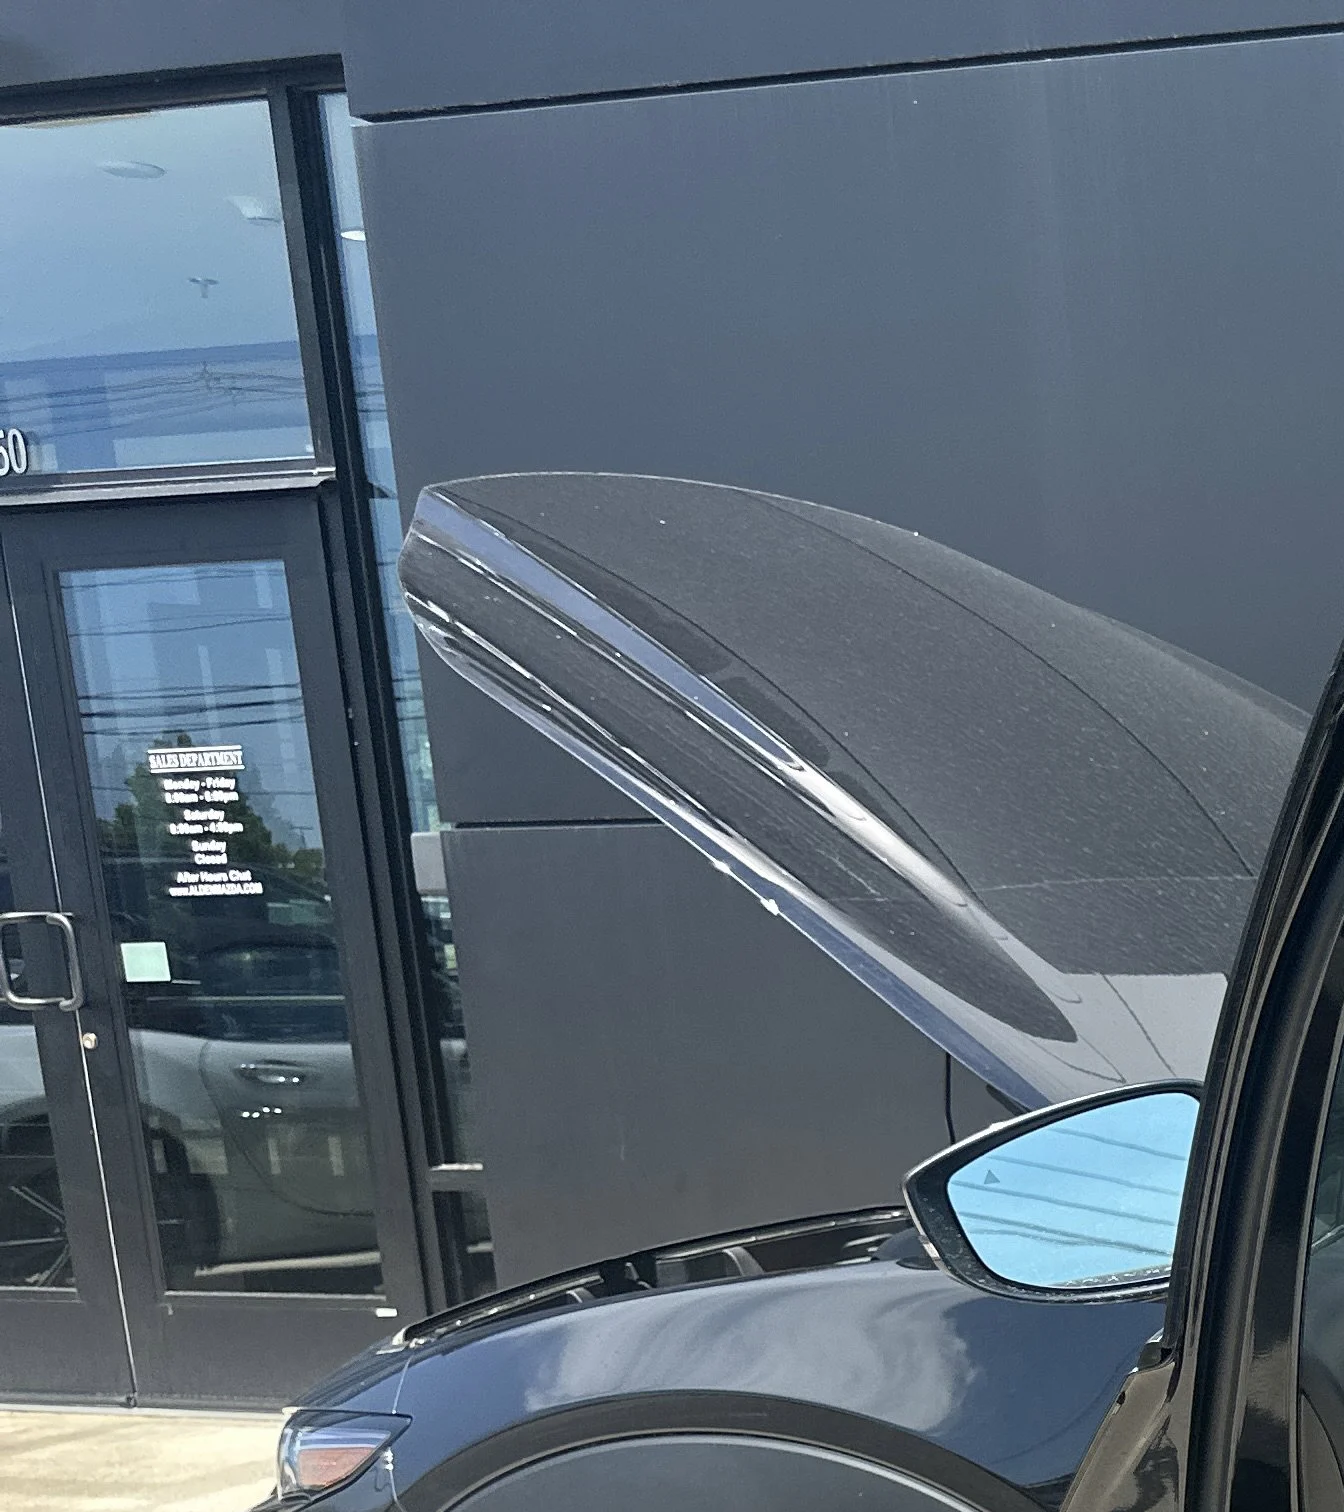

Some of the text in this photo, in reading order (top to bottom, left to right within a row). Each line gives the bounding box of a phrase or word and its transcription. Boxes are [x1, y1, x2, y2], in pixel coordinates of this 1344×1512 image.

[148, 750, 243, 769] SALES DEPARTMENT
[163, 778, 200, 791] Monday
[205, 776, 236, 790] Friday
[183, 808, 225, 822] Saturday
[190, 840, 227, 853] Sunday
[194, 853, 228, 865] Closed
[176, 869, 252, 884] After Hours Chat
